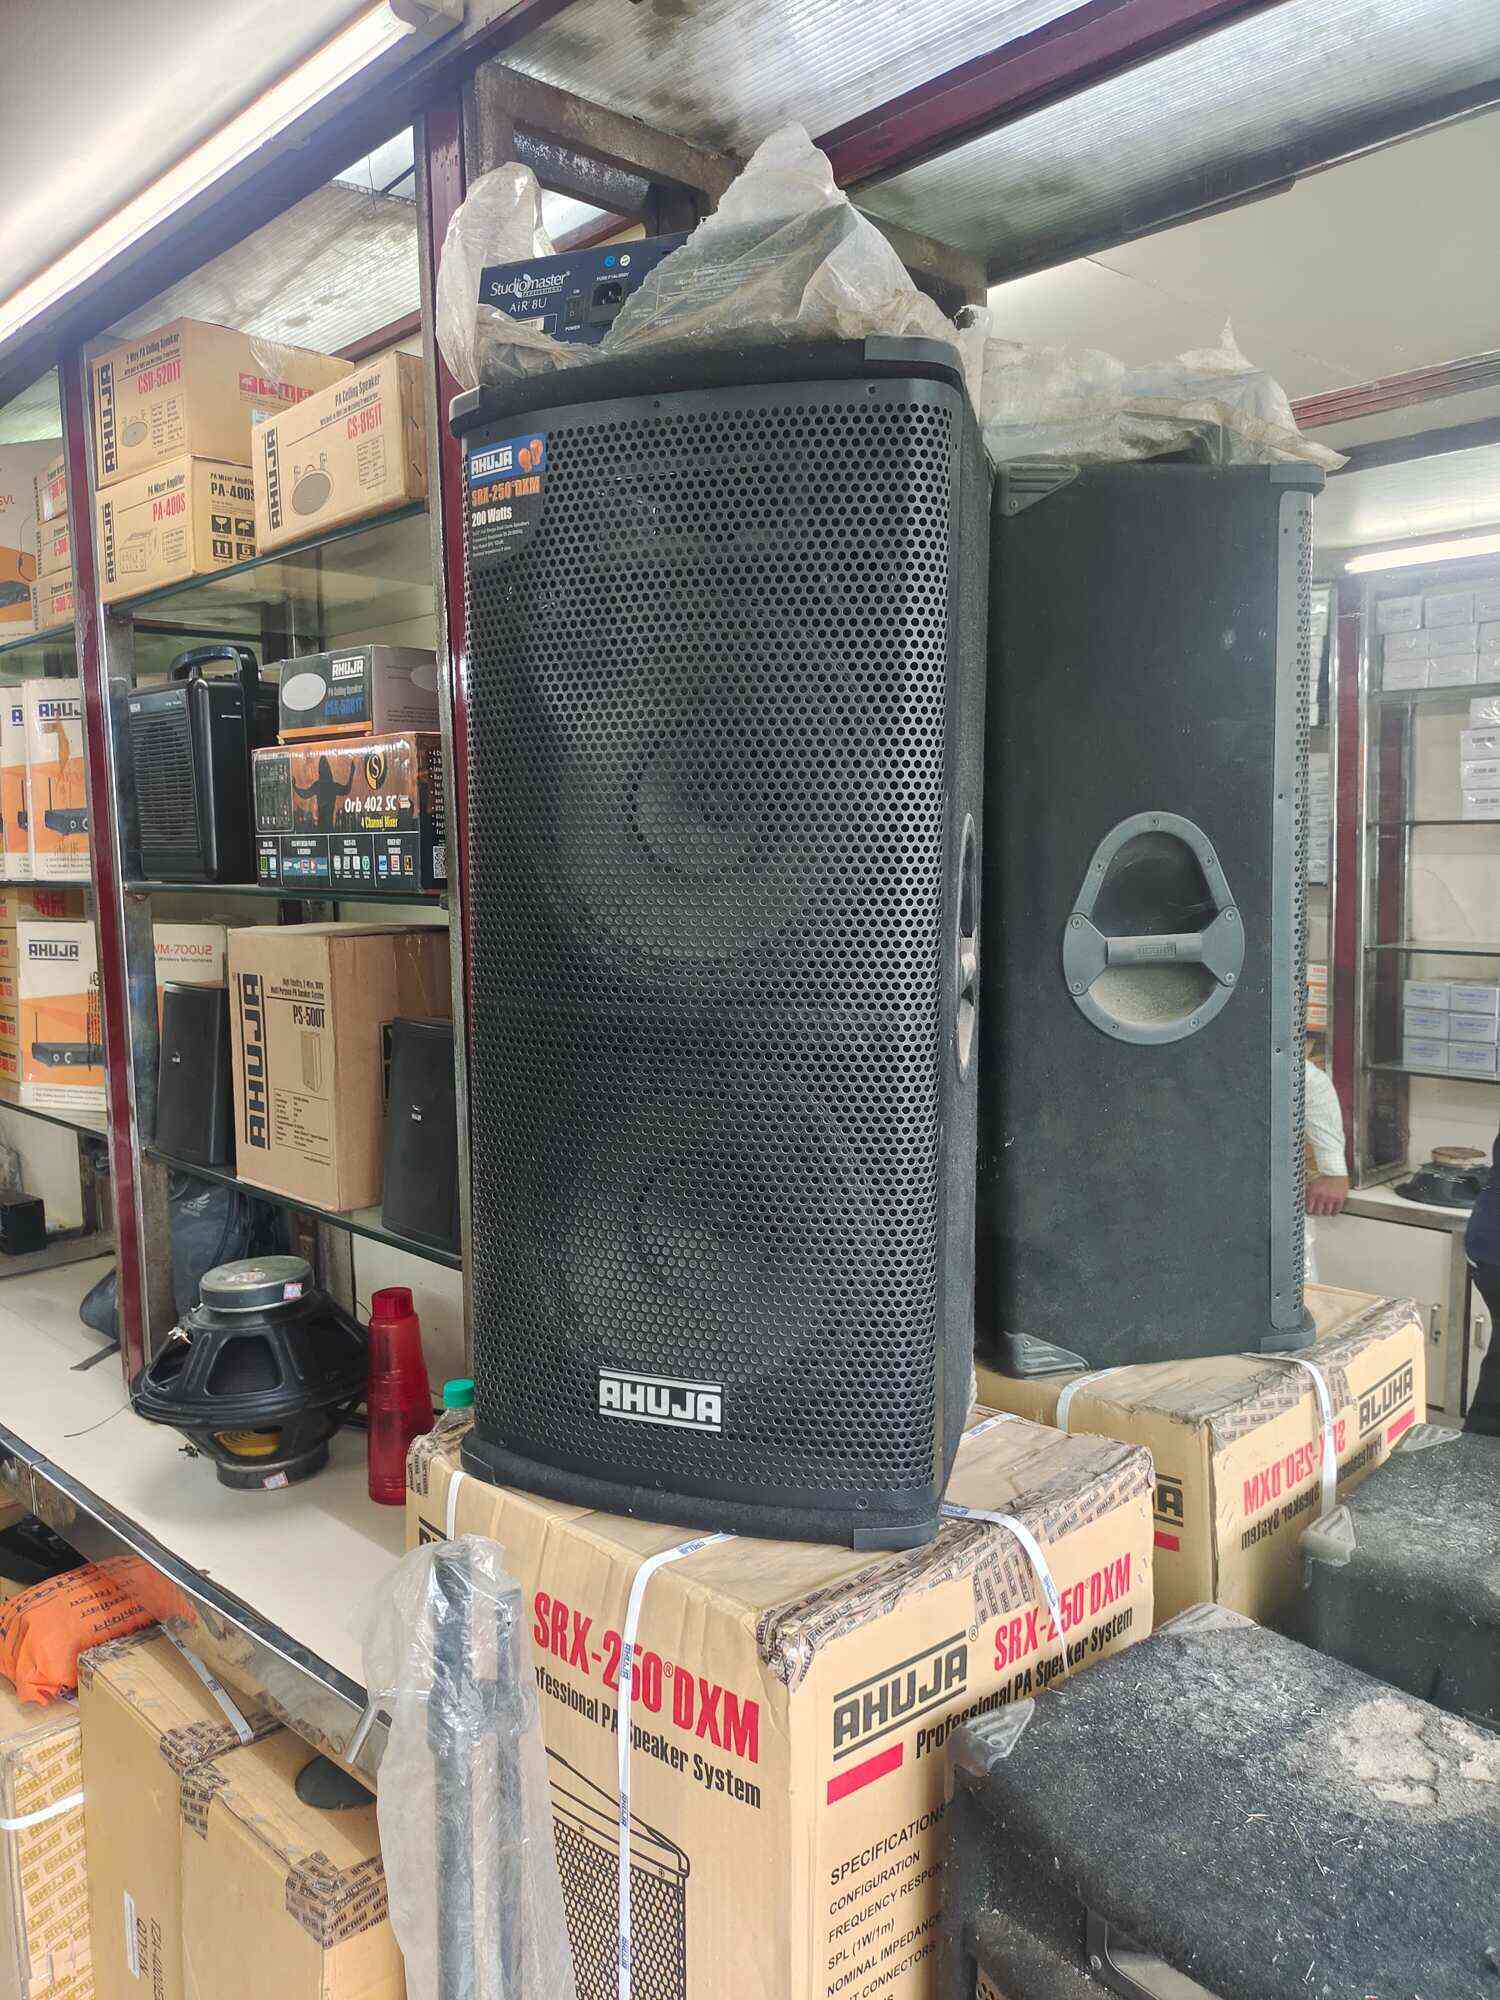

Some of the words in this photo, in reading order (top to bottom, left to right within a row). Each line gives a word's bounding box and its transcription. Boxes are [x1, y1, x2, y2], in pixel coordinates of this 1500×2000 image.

[490, 273, 567, 297] Studiomaster
[532, 298, 548, 310] 8U
[565, 324, 581, 332] POWER
[335, 394, 342, 407] PA
[358, 374, 381, 397] Speaker
[99, 363, 117, 473] AHUJA
[265, 428, 283, 531] AHUJA
[471, 446, 513, 479] AHUJA
[152, 493, 186, 522] PA-400S
[472, 511, 486, 527] 200
[487, 506, 512, 523] Watts
[104, 500, 117, 584] AHUJA
[332, 656, 365, 681] AHUJA
[344, 797, 362, 814] Orb
[364, 796, 382, 812] 402
[385, 795, 397, 809] SC
[29, 940, 79, 961] AHUJA
[293, 1005, 325, 1028] PS-500T
[239, 973, 269, 1150] AHUJA
[599, 1375, 721, 1425] AHUJA
[1090, 1552, 1131, 1617] DXM
[1014, 1668, 1033, 1702] PA
[1090, 1606, 1133, 1652] System
[673, 1665, 760, 1764] DXM
[693, 1753, 761, 1810] System
[829, 1851, 920, 1915] CONFIGURATION
[828, 1890, 898, 1943] FREQUENCY
[828, 1946, 849, 1970] SPL
[852, 1918, 895, 1957] (1W/1m)
[828, 1957, 877, 1997] NOMINAL
[862, 1941, 937, 1998] CONNECTORS
